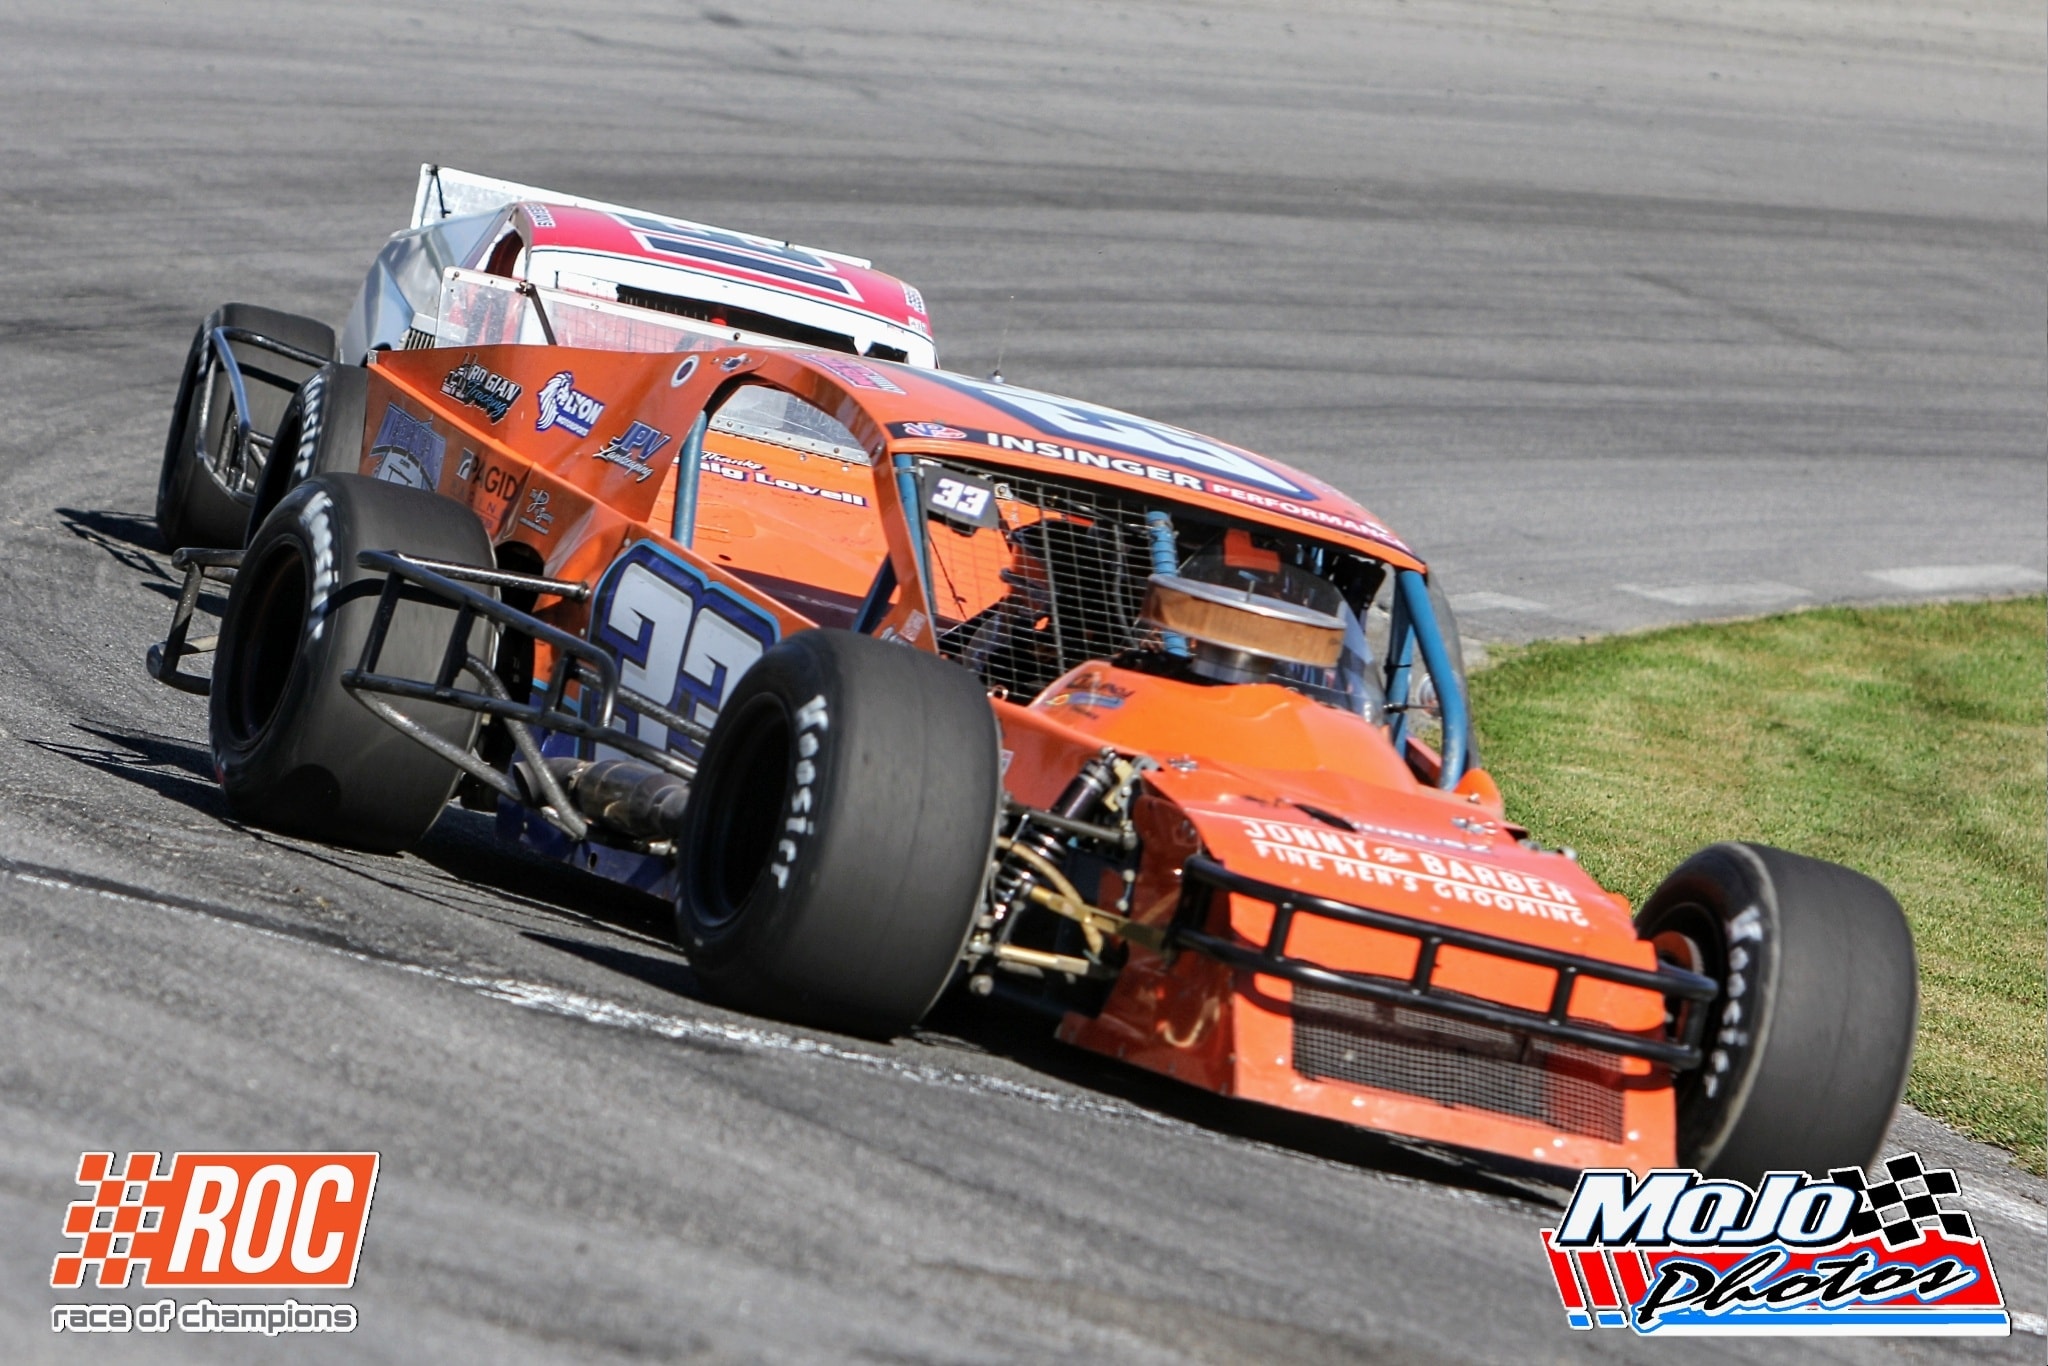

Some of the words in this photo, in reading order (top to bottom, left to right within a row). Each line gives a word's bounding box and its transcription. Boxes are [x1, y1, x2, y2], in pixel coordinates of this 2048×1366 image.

[466, 381, 507, 418] Trucking
[484, 373, 520, 401] GIAN
[609, 421, 671, 460] JPV
[592, 443, 655, 482] Landscaping
[701, 451, 763, 470] Thanks
[987, 432, 1204, 492] INSINGER
[754, 472, 867, 507] Lovell
[932, 478, 990, 515] 33
[1240, 820, 1369, 860] JONNY
[1418, 852, 1579, 905] BARBER
[1252, 843, 1325, 872] FINE
[1334, 859, 1420, 893] MEN'S
[1432, 882, 1591, 928] GROOMING
